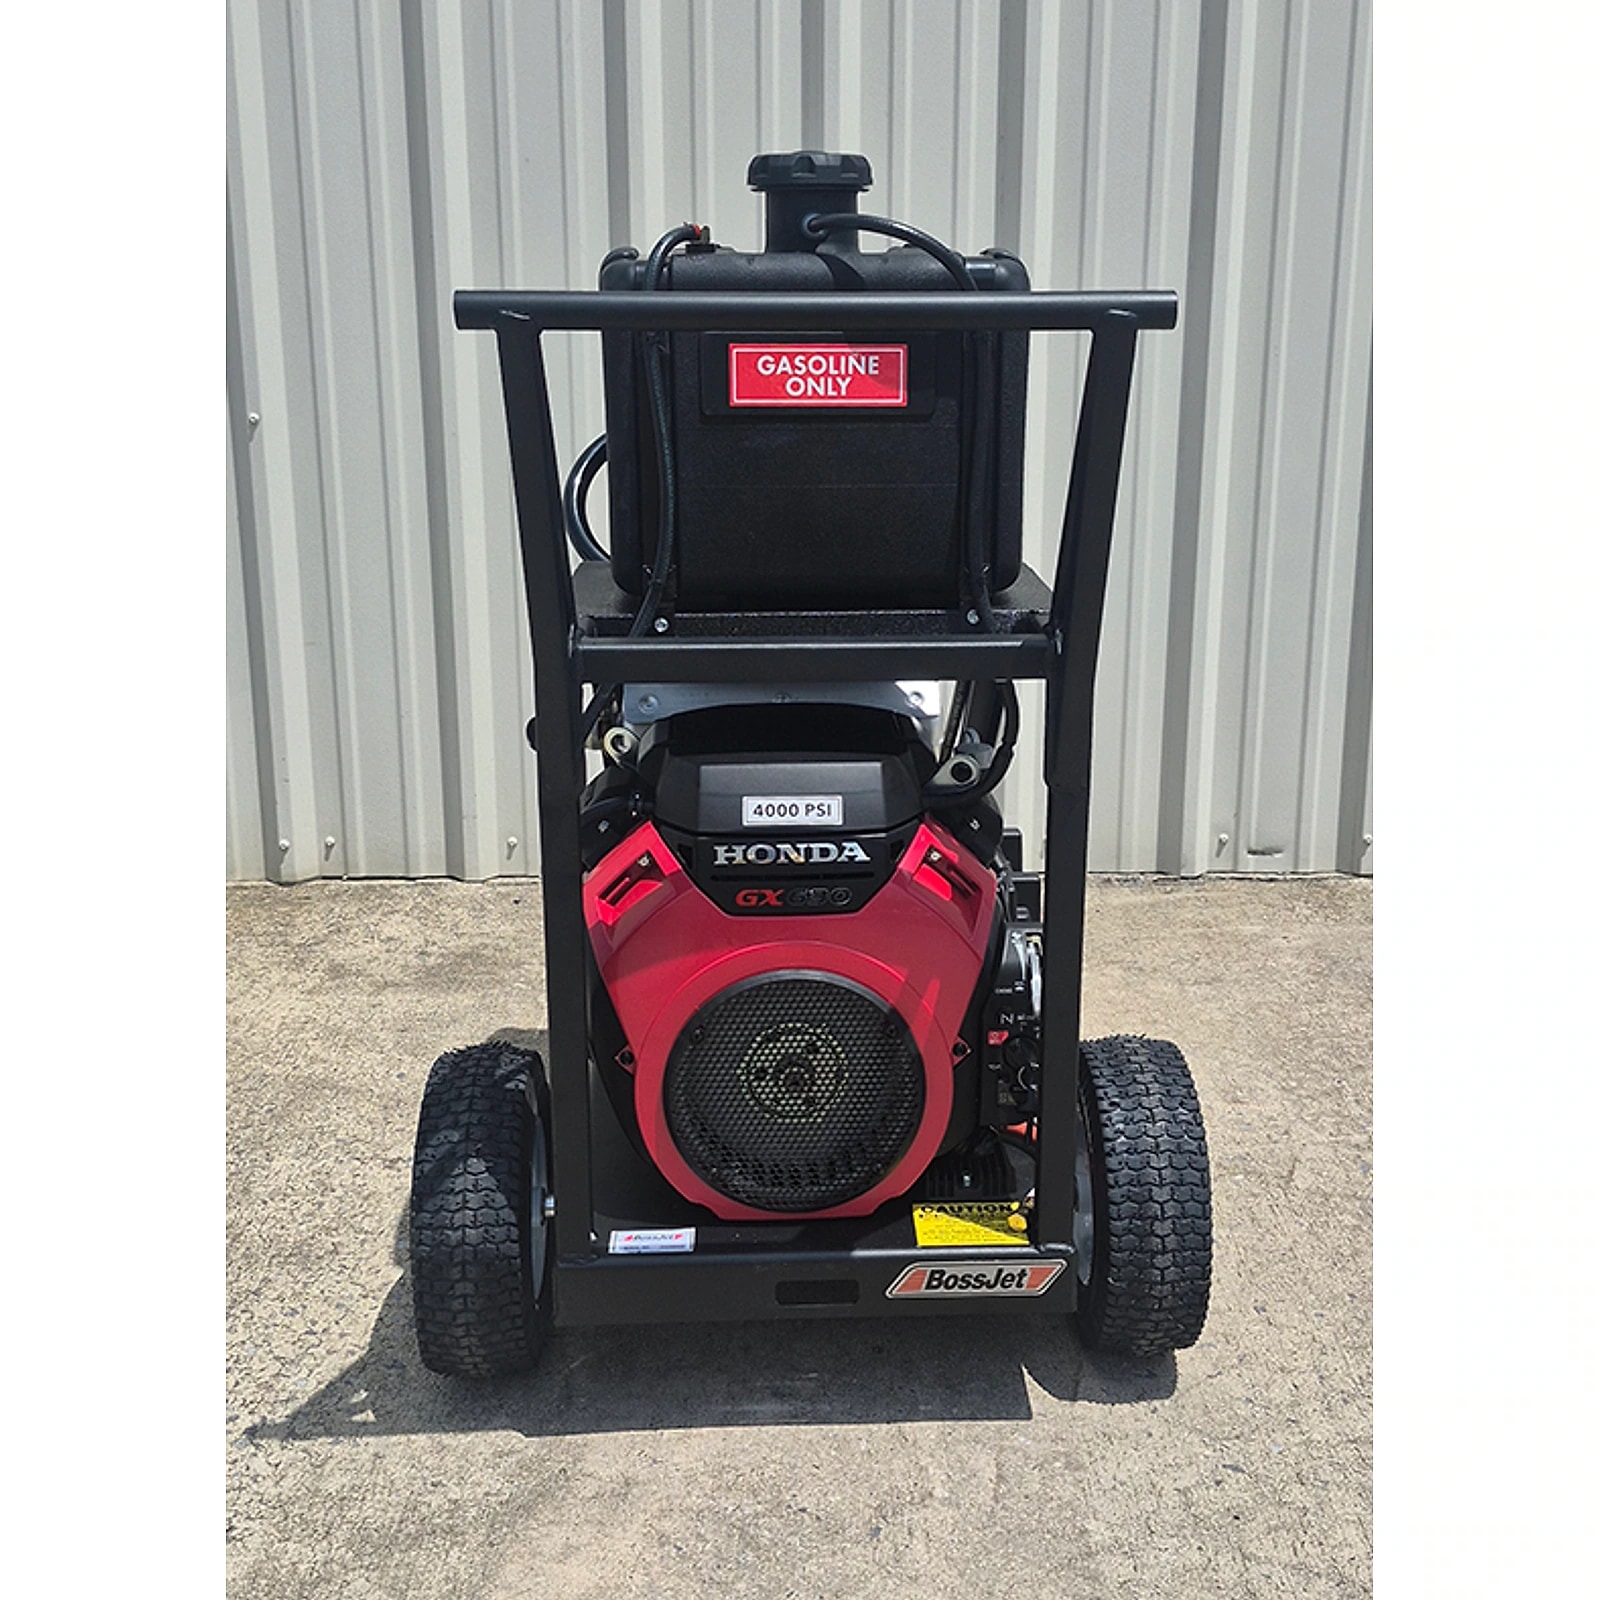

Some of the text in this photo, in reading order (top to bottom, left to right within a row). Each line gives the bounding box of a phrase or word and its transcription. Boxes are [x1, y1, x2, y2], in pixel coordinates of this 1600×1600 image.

[757, 354, 880, 376] GASOLINE
[785, 377, 852, 397] ONLY
[753, 803, 832, 818] 4000 PSI
[713, 841, 871, 865] HONDA
[920, 1204, 1013, 1213] CAUTION
[924, 1268, 1028, 1291] BossJet
